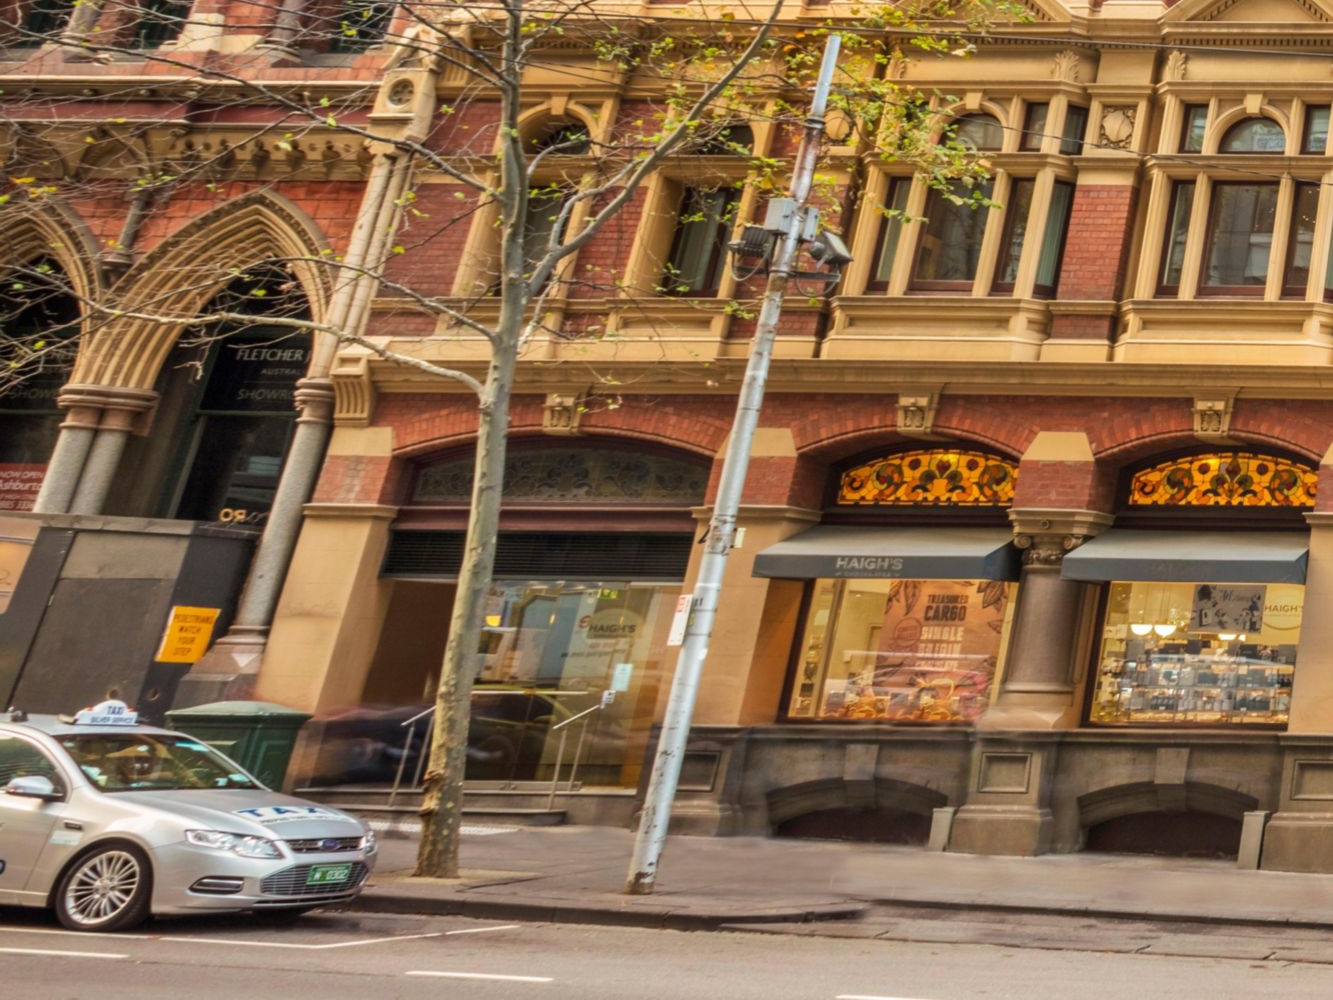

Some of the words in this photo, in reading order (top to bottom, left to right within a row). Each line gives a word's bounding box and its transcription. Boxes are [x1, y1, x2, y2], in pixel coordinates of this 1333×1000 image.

[236, 349, 304, 361] FLETCHER
[836, 557, 903, 570] HAIGH'S
[924, 605, 967, 621] CARGO
[589, 624, 636, 633] HAIGH'S
[920, 626, 965, 641] SINGLE
[107, 706, 125, 715] TAXI
